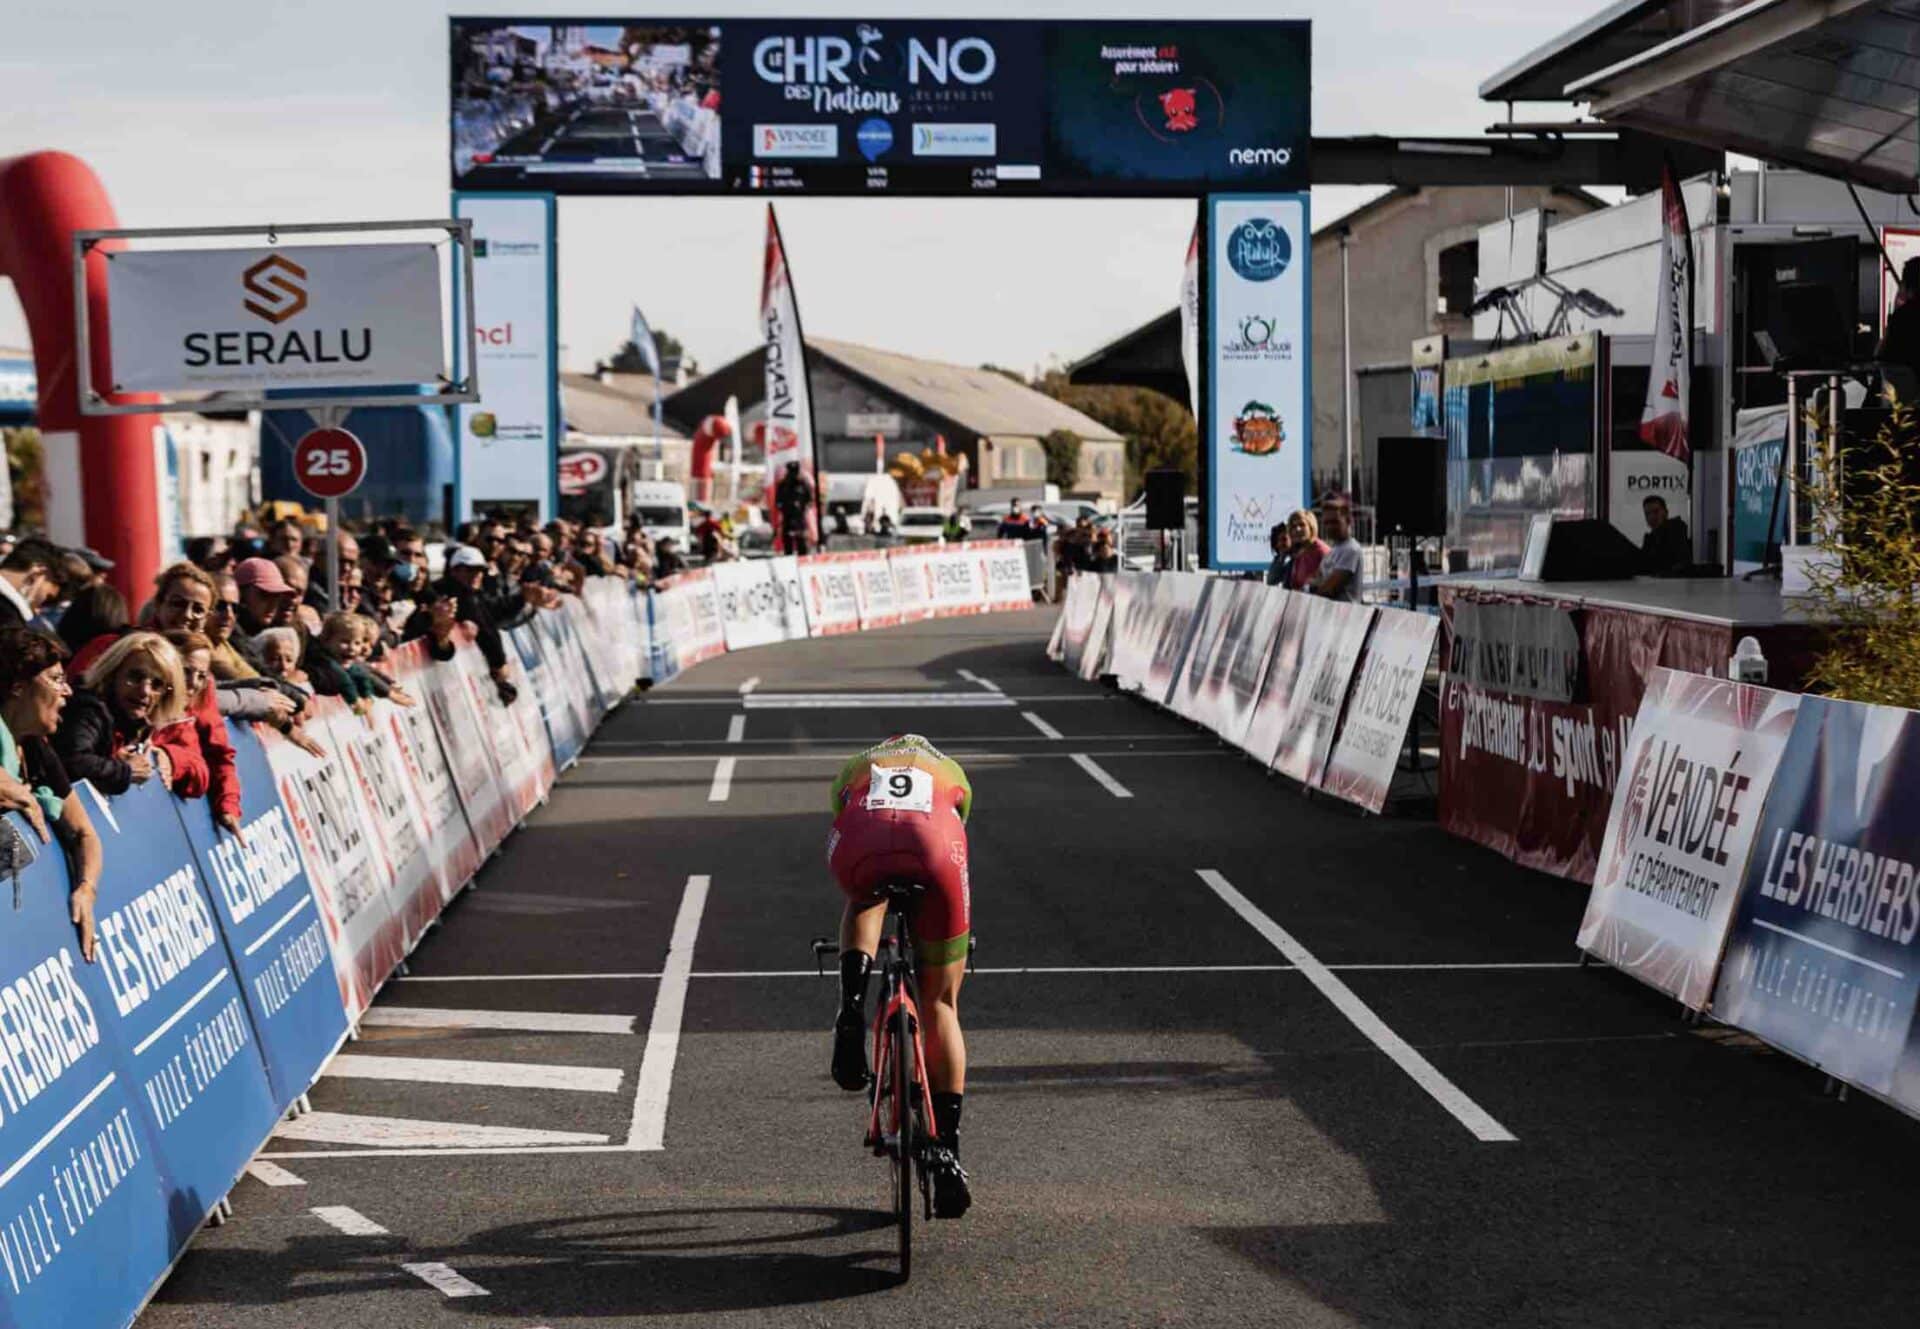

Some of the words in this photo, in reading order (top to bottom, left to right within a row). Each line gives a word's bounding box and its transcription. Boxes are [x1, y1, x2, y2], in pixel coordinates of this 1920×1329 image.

[784, 85, 811, 99] DES
[813, 86, 900, 114] Nations
[1229, 148, 1290, 165] nemo
[184, 328, 371, 367] SERALU
[306, 448, 351, 477] 25
[1627, 474, 1685, 489] PORTIX
[888, 774, 913, 798] 9
[1551, 708, 1603, 798] sport
[1644, 740, 1751, 867] VENDÉE
[207, 834, 255, 925] LES
[243, 805, 301, 906] HERBIERS
[1640, 852, 1720, 921] DÉPARTEMENT
[1760, 827, 1815, 906] LES
[1804, 839, 1920, 945] HERBIERS
[93, 911, 151, 1018] LES
[124, 863, 216, 991] HERBIERS
[254, 958, 290, 1019] VILLE
[145, 1055, 193, 1131] VILLE
[184, 997, 248, 1092] ÉVÉNEMENT
[0, 1193, 61, 1294] VILLE
[53, 1107, 140, 1236] ÉVÉNEMENT
